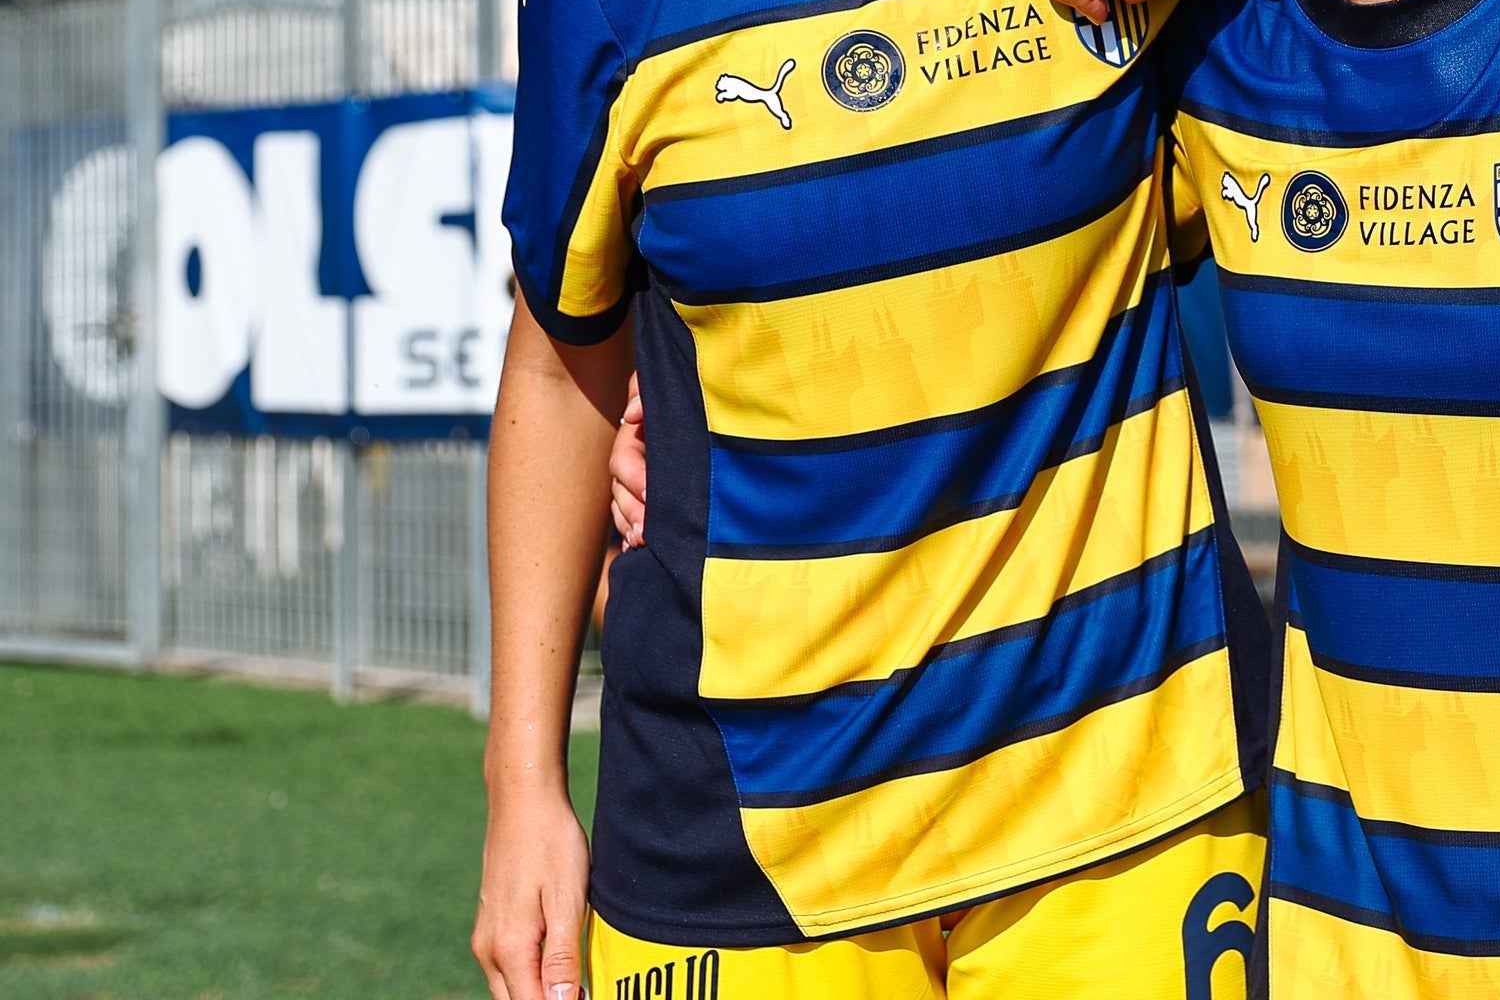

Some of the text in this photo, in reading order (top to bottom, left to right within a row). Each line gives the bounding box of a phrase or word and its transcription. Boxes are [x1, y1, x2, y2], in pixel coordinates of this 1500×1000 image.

[915, 3, 1044, 55] FIDENZA
[919, 36, 1053, 85] VILLAGE
[1359, 183, 1476, 211] FIDENZA
[1359, 219, 1476, 246] VILLAGE
[1181, 871, 1256, 1000] 6
